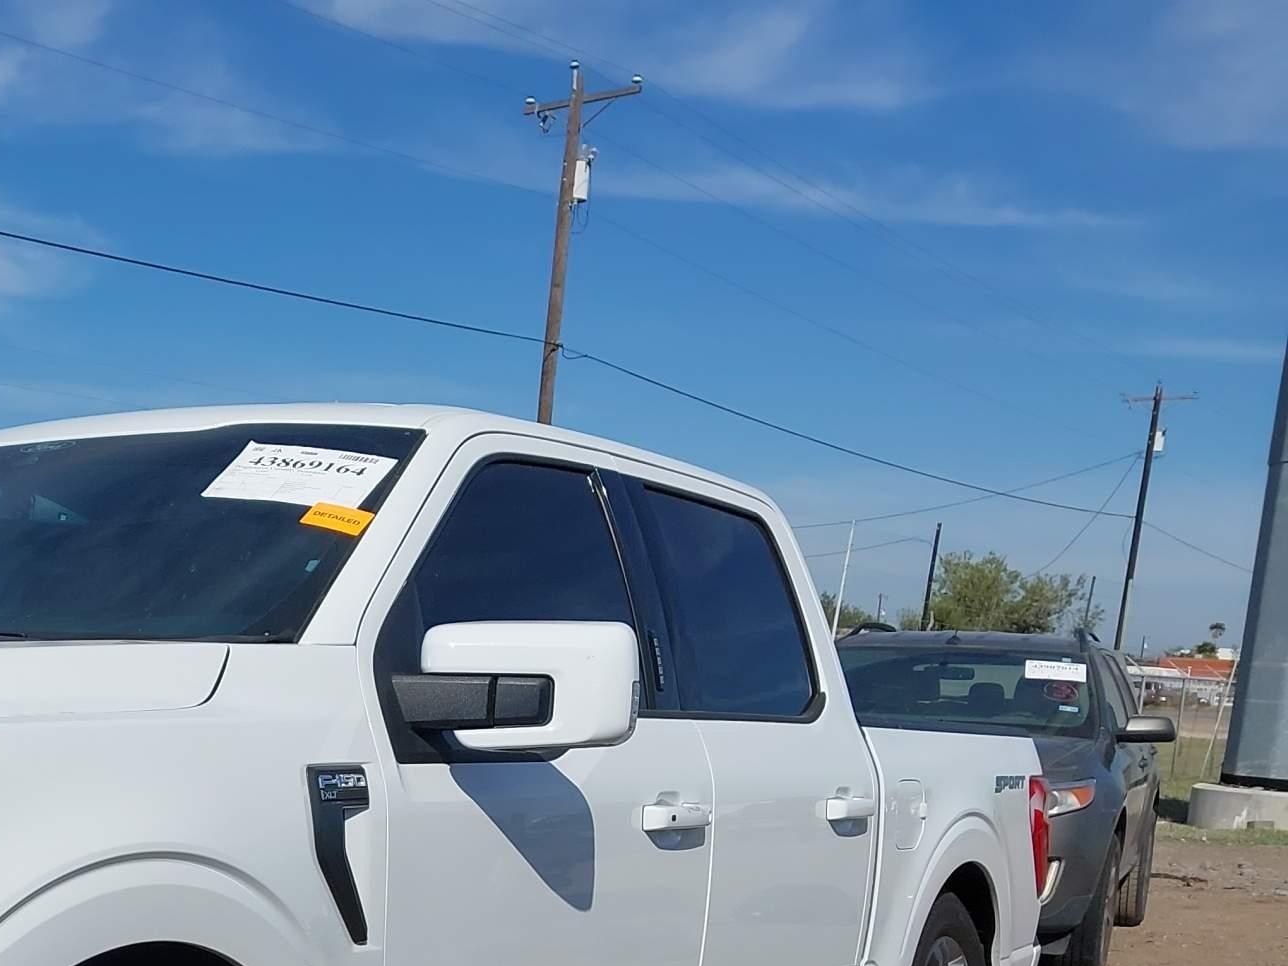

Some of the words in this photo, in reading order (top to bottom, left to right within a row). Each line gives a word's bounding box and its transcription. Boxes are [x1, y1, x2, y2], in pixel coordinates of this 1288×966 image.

[249, 455, 367, 477] 43869164
[312, 509, 362, 527] DETAILED
[994, 775, 1026, 793] SPORT
